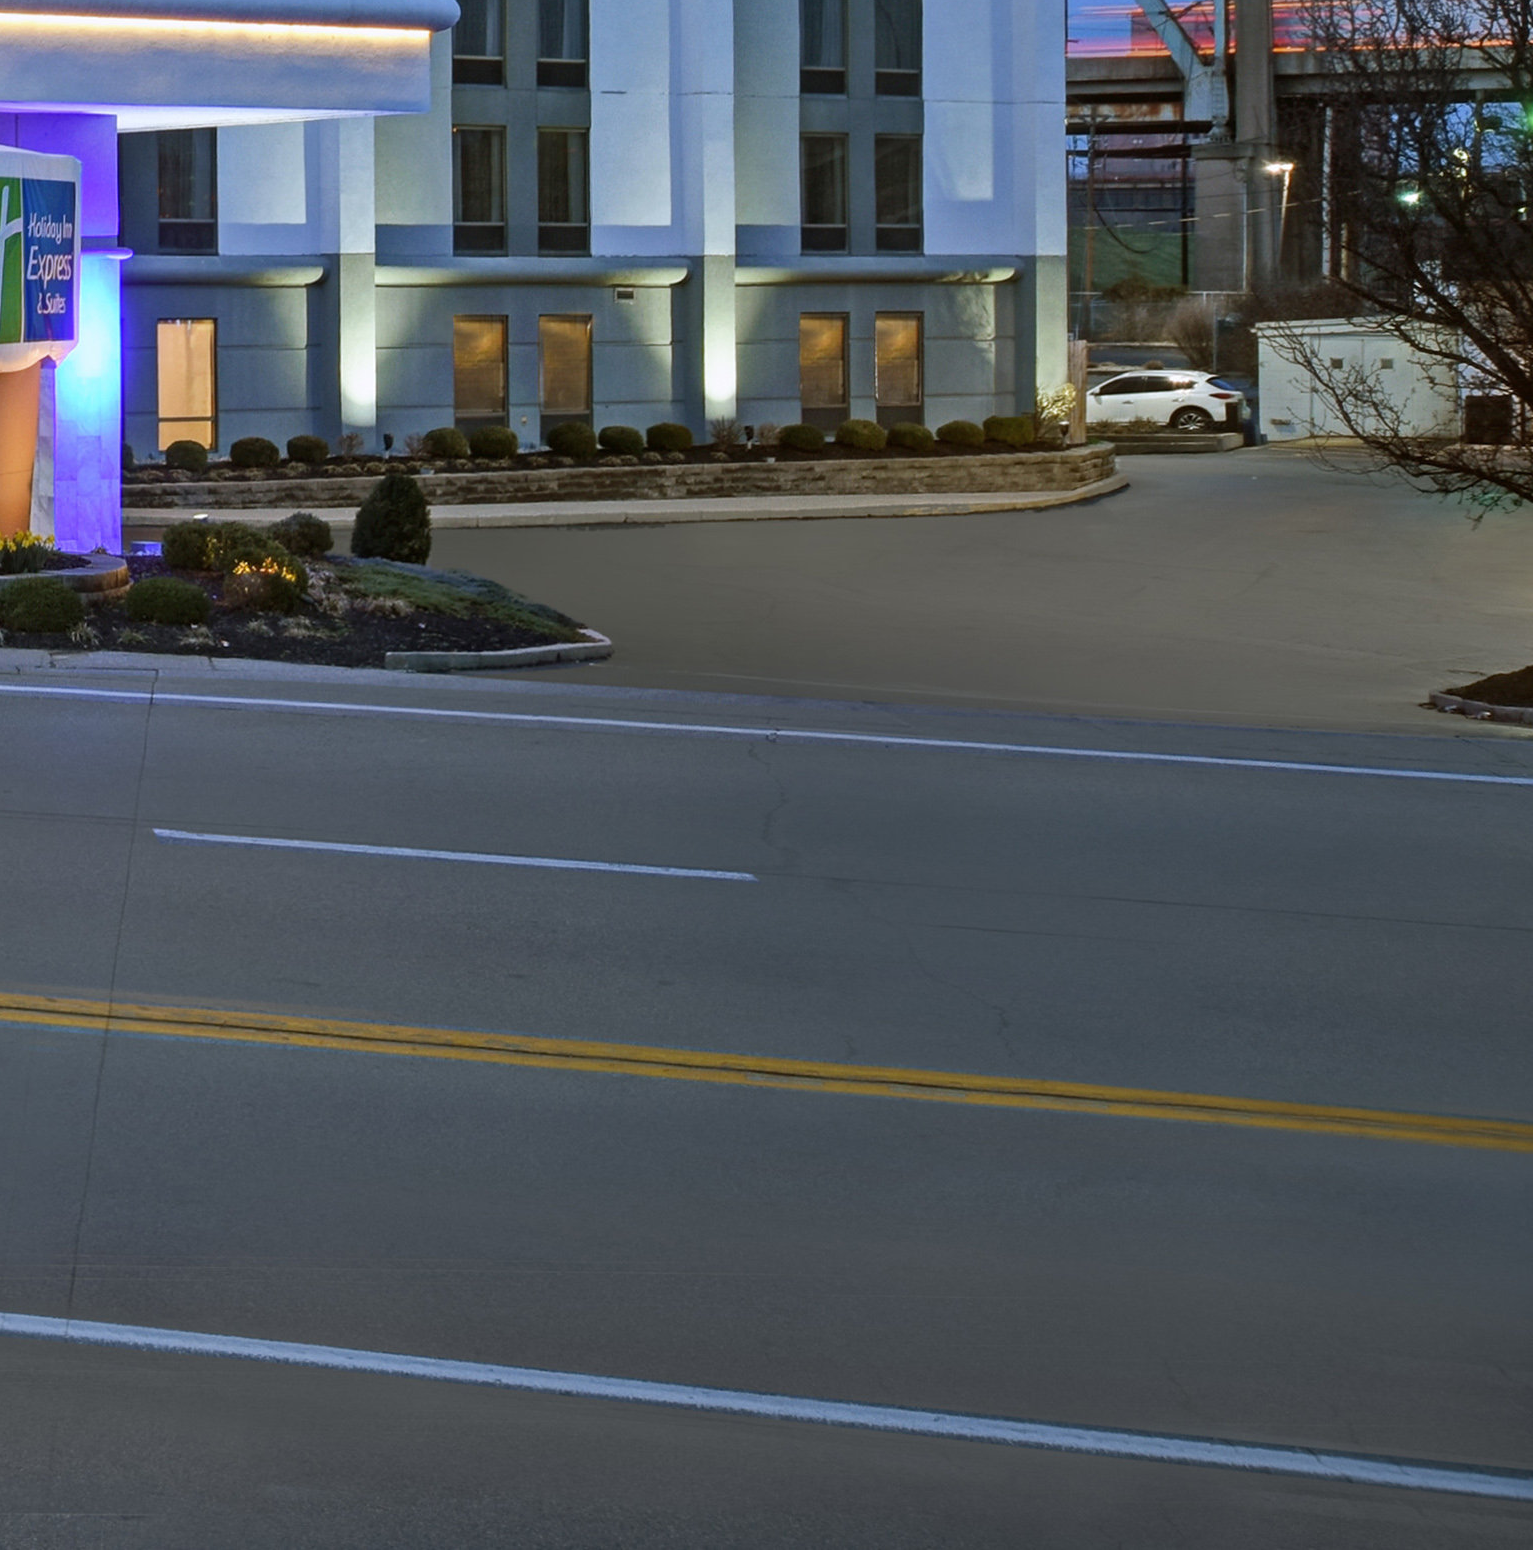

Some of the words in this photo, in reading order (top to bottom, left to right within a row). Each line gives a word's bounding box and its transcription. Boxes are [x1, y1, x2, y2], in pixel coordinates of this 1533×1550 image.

[27, 212, 63, 244] Holiday
[62, 214, 73, 239] Inn
[26, 245, 72, 290] Express
[42, 292, 66, 314] Suites
